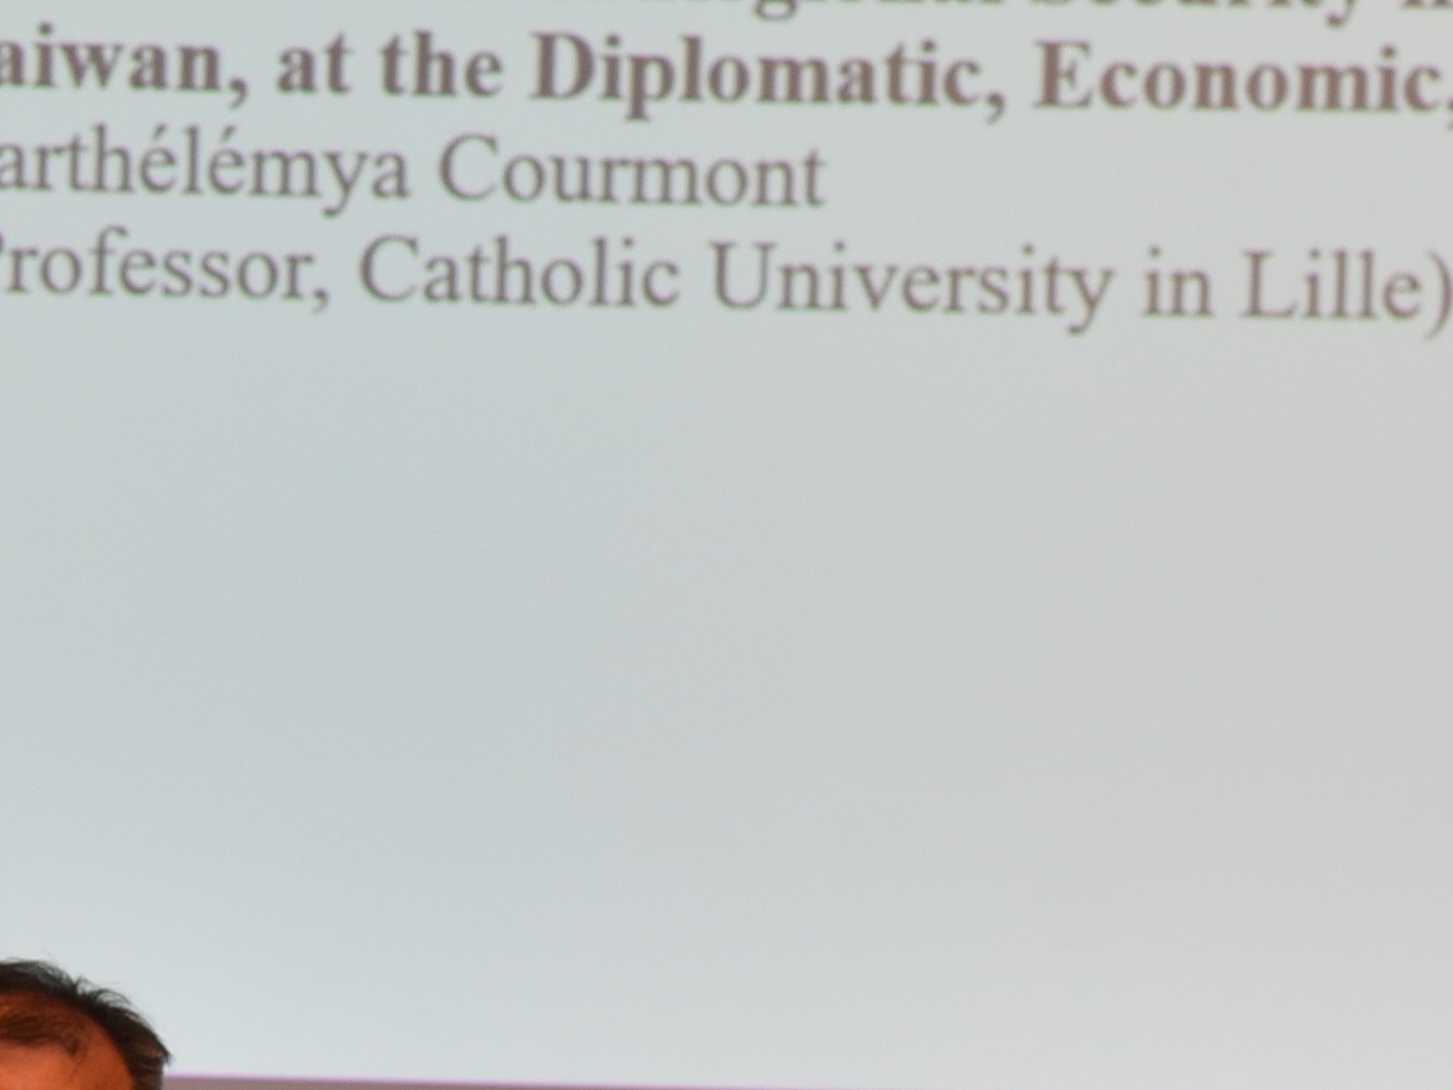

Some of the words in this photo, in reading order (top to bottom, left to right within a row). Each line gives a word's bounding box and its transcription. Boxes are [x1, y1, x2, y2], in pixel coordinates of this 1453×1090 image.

[275, 33, 351, 96] at
[379, 29, 504, 99] the
[530, 31, 1006, 124] Diplomatic,
[438, 133, 824, 208] Courmont
[358, 234, 680, 308] Catholic
[709, 240, 1115, 337] University
[1142, 245, 1214, 318] in
[1242, 248, 1453, 344] Lille)
